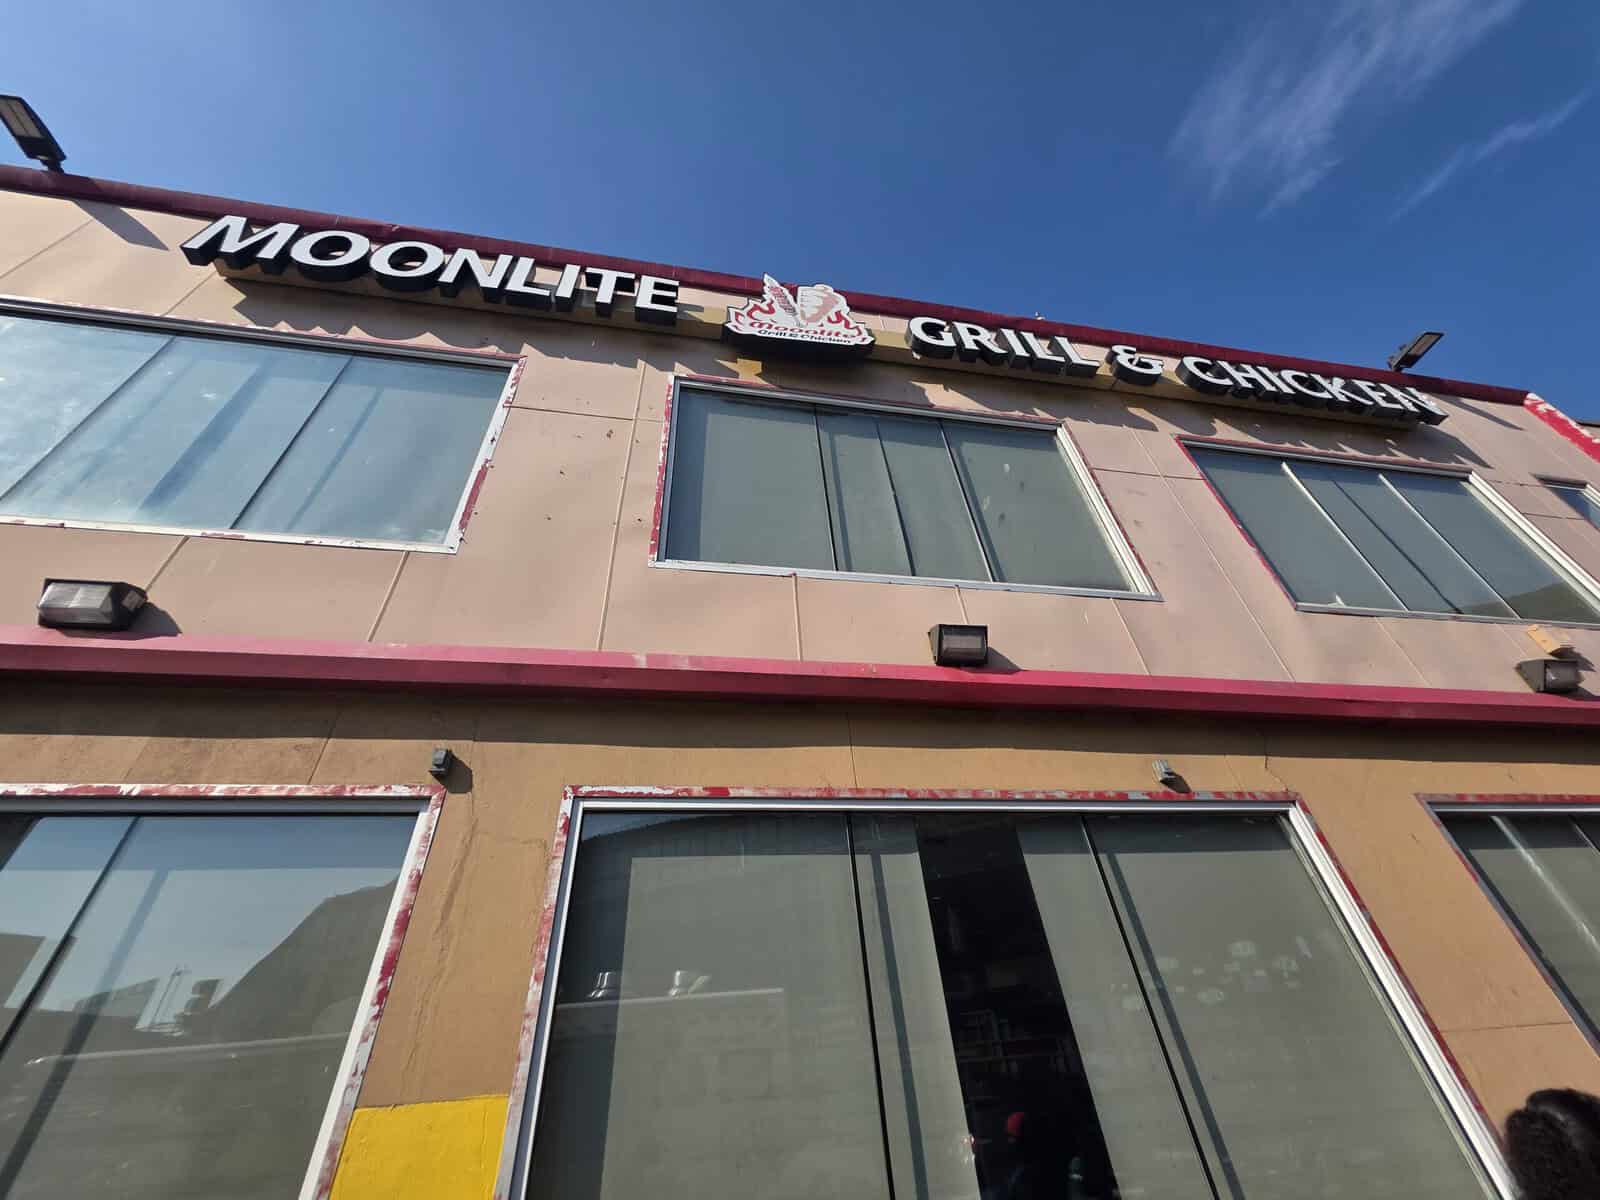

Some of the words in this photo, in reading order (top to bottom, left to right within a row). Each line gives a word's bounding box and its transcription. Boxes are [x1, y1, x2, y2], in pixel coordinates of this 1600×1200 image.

[182, 214, 681, 312] MOONLITE
[908, 316, 1101, 369] GRILL
[1109, 345, 1165, 376] &
[1180, 356, 1448, 417] CHICKEN
